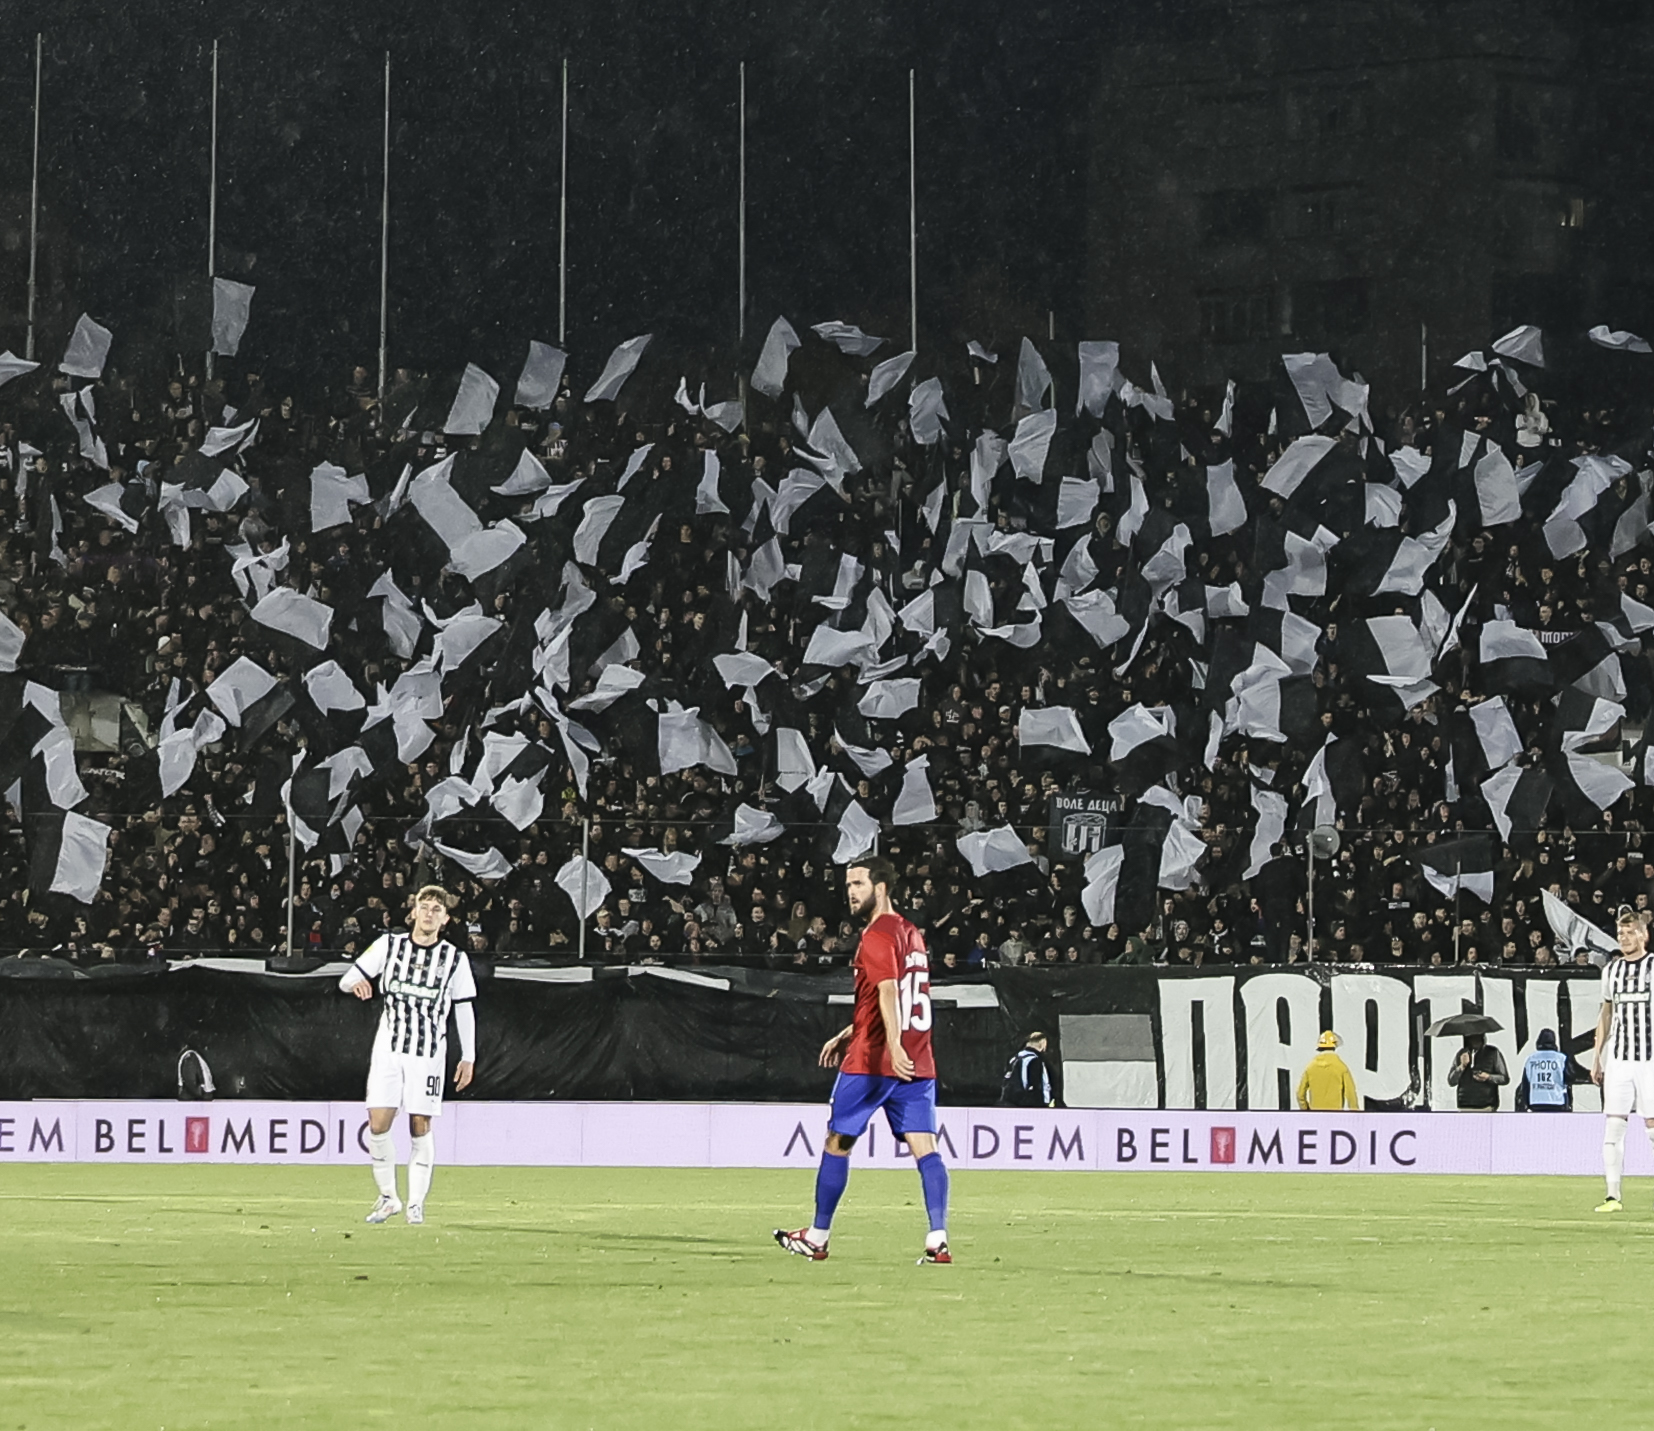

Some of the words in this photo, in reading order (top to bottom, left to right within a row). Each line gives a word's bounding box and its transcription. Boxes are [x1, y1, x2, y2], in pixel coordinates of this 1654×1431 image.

[900, 972, 932, 1032] 15
[1530, 1060, 1558, 1071] PHOTO
[426, 1075, 440, 1097] 90
[95, 1118, 174, 1154] BEL
[782, 1120, 1086, 1162] AIADEM
[1117, 1127, 1198, 1164] BEL
[1247, 1127, 1417, 1167] MEDIC
